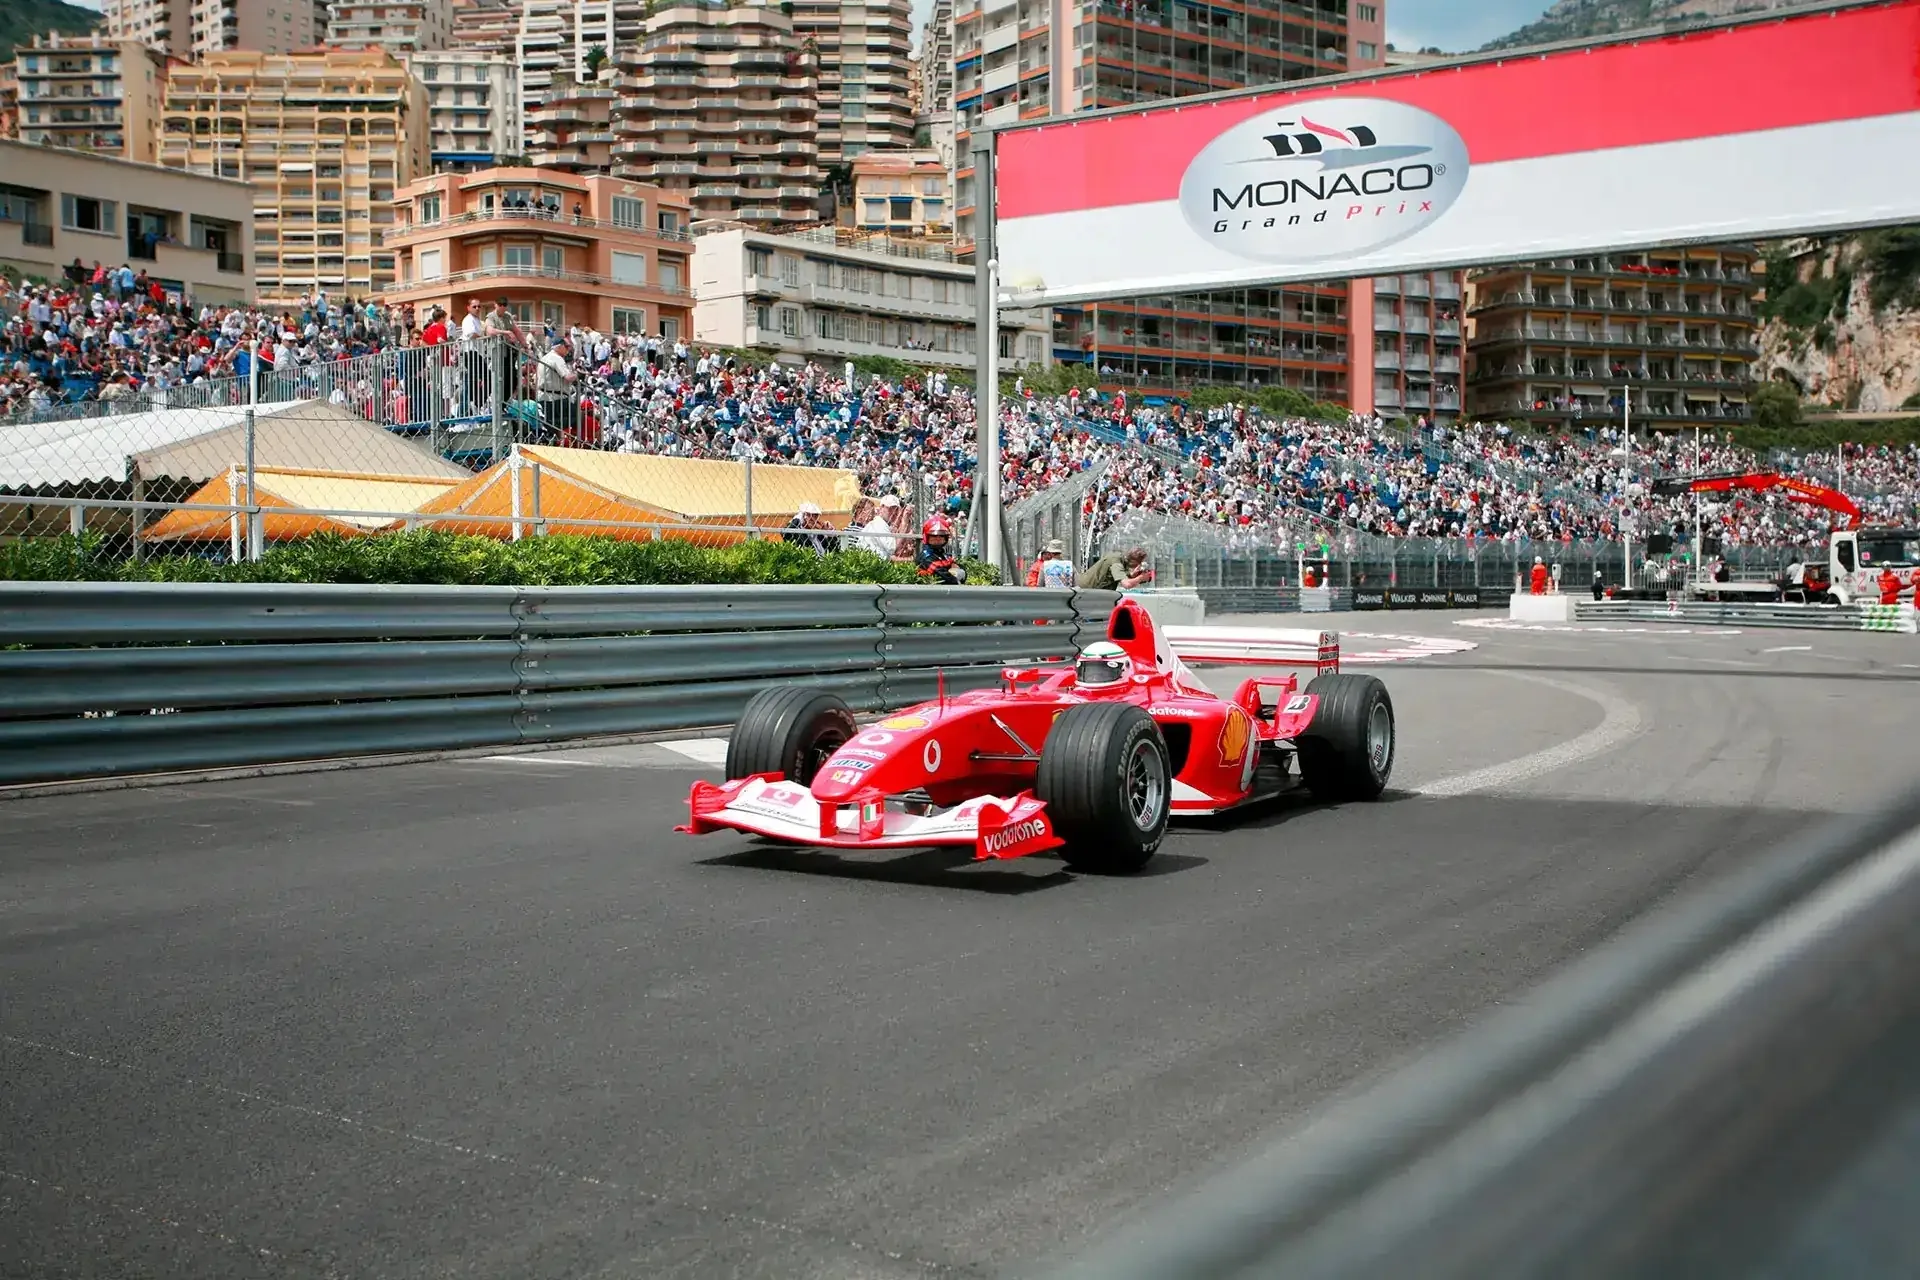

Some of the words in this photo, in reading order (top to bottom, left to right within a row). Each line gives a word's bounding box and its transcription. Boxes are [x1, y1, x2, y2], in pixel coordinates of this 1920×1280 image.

[1213, 163, 1433, 212] MONACO
[1213, 210, 1327, 233] Grand
[1346, 200, 1432, 220] Prix
[1355, 593, 1383, 604] JOHNNIE
[1390, 593, 1417, 603] WALKER
[1420, 592, 1447, 603] JOHNNIE
[1453, 592, 1478, 602] WALKER
[1147, 706, 1194, 717] dafone
[983, 818, 1046, 853] vodafone
